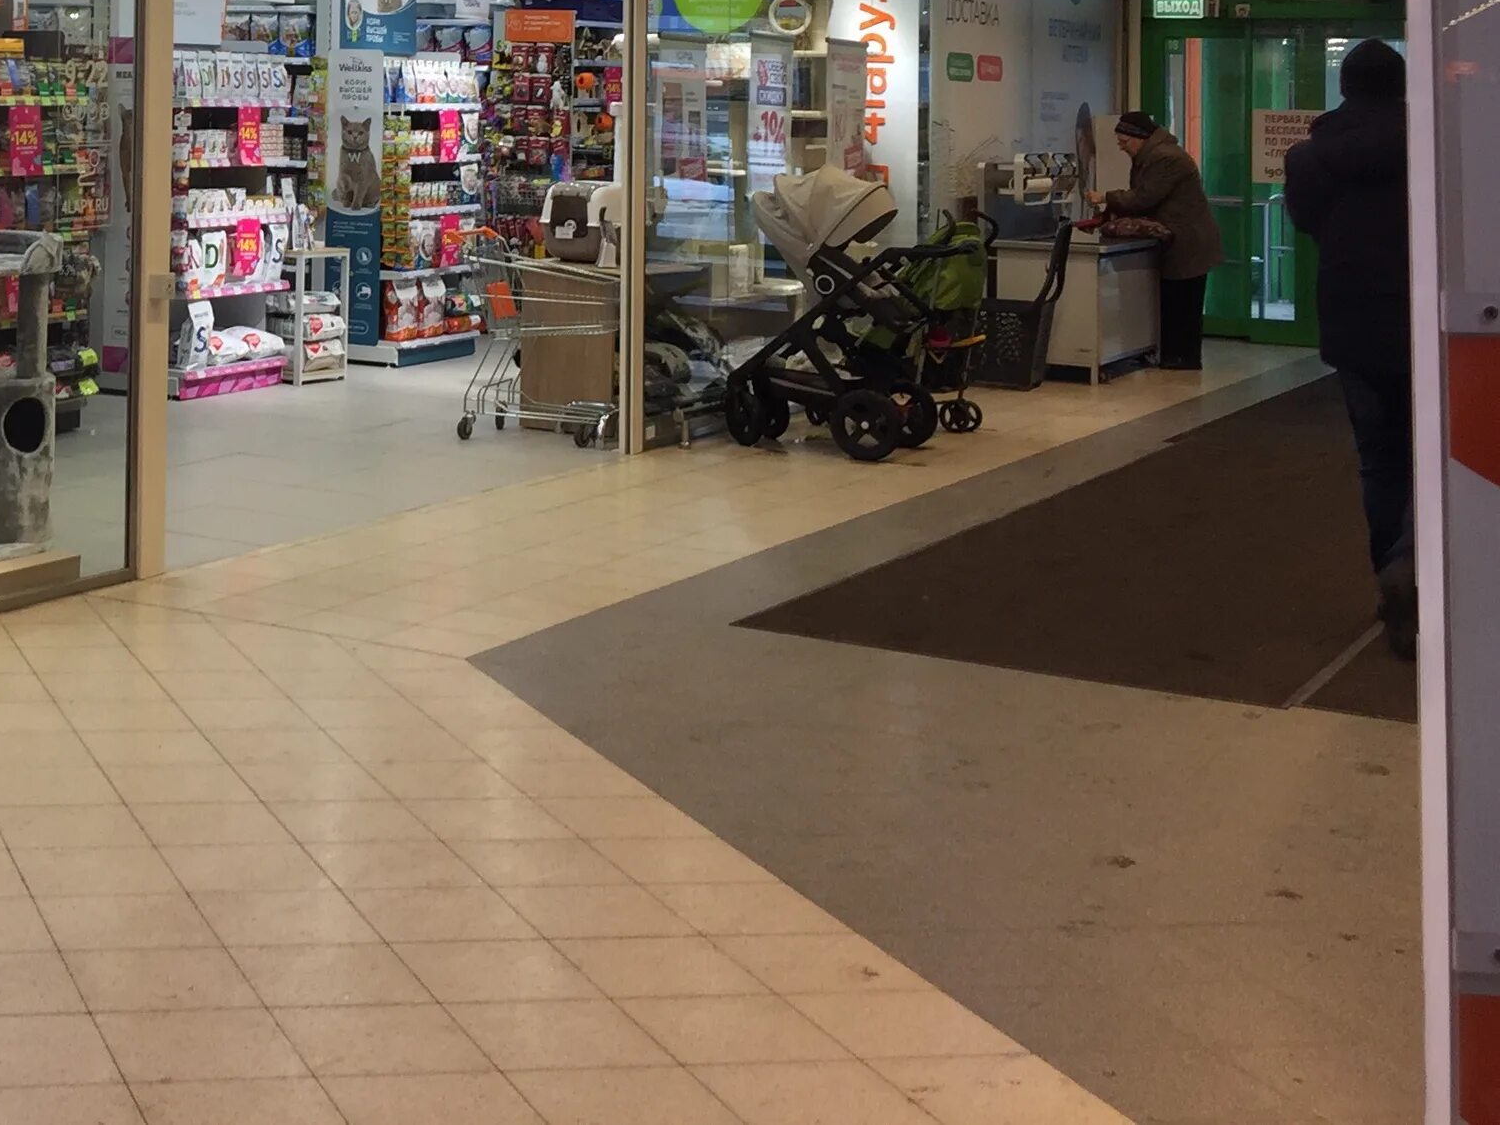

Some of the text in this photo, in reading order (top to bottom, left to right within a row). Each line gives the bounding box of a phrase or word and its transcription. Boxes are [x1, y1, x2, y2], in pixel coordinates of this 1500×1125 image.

[1156, 0, 1200, 15] ВЫХОД
[1264, 114, 1302, 124] ПЕРВАЯ
[11, 129, 38, 146] -14%
[1264, 137, 1278, 147] ПО
